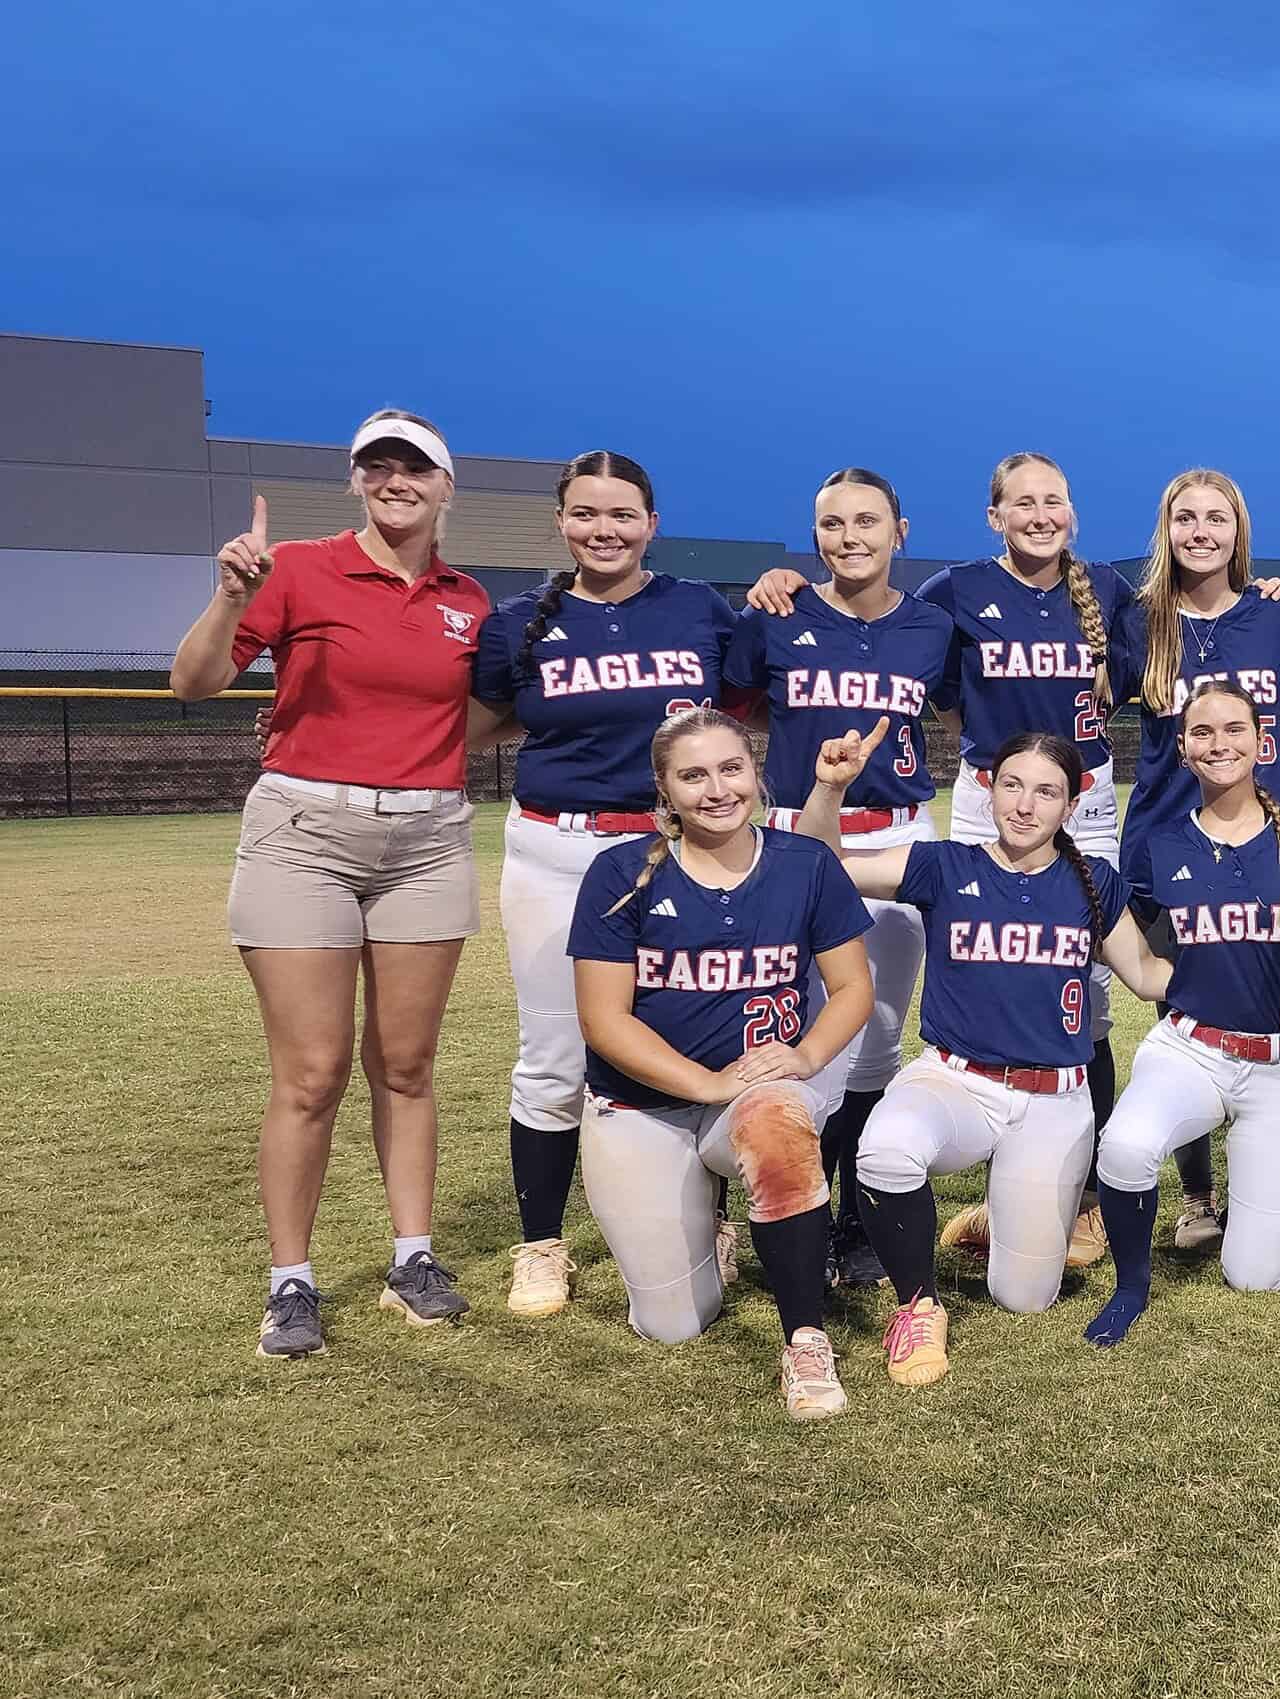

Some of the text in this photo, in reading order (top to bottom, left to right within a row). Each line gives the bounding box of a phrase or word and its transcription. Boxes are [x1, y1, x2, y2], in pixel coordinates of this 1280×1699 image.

[539, 650, 705, 698] EAGLES
[979, 640, 1096, 679] EAGLE
[787, 668, 927, 718] EAGLES
[893, 725, 917, 777] 3
[635, 944, 799, 992] EAGLES
[949, 920, 1091, 967] EAGLES
[743, 987, 800, 1054] 28
[1060, 979, 1083, 1034] 9
